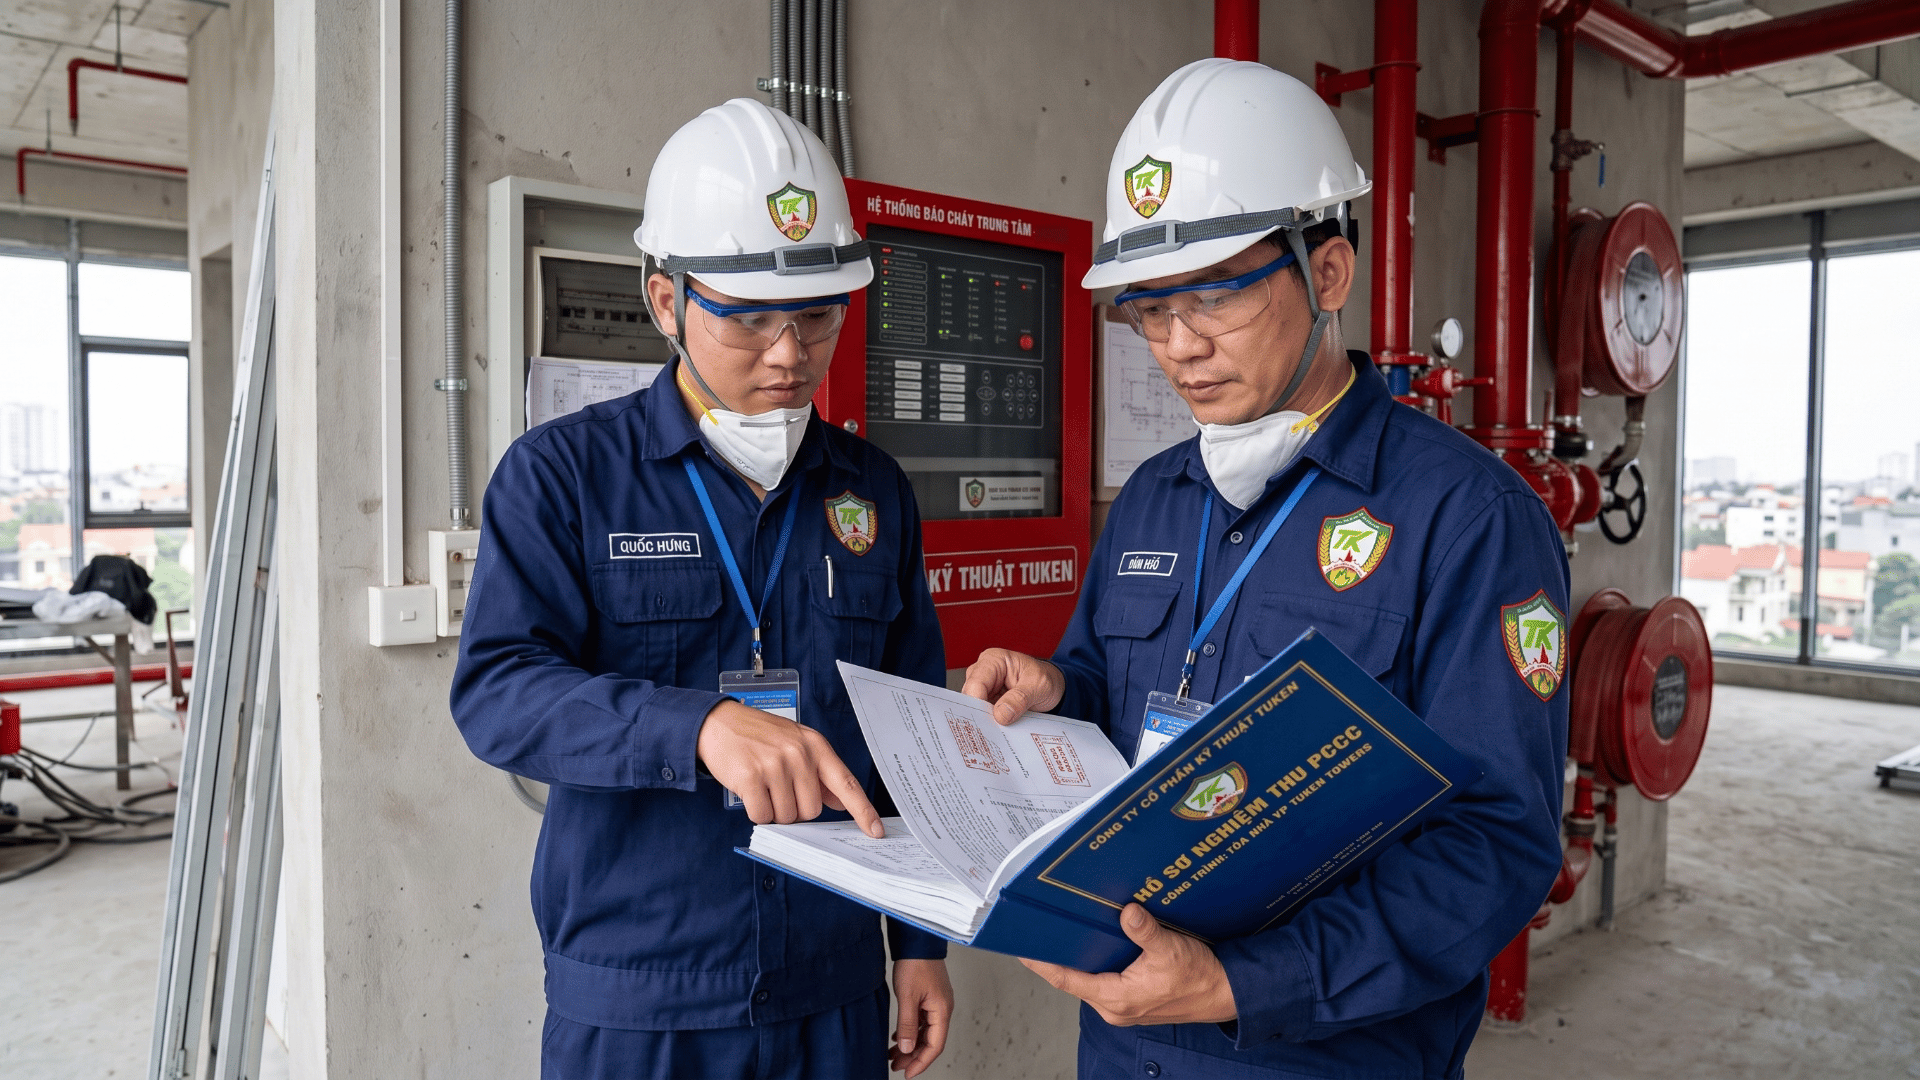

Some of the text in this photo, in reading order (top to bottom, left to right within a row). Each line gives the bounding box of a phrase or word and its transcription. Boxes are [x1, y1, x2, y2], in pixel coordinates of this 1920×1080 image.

[1135, 168, 1161, 190] TK
[778, 196, 805, 215] TK
[867, 195, 882, 215] HỆ
[885, 198, 921, 220] THỐNG
[947, 210, 974, 228] CHÁY
[977, 215, 1009, 234] TRUNG
[1011, 219, 1032, 237] TÂM
[838, 507, 864, 525] TK
[620, 536, 691, 553] QUỐC HƯNG
[1332, 528, 1375, 553] TK
[929, 559, 1073, 593] KỸ THUẬT TUKEN
[1522, 619, 1558, 650] TK
[1089, 822, 1123, 850] CÔNG
[1122, 807, 1139, 822] TY
[1212, 715, 1254, 749] THUẬT
[1255, 681, 1299, 717] TUKEN
[1162, 854, 1193, 880] SƠ
[1191, 797, 1270, 858] NGHIỆM
[1266, 765, 1308, 798] THU
[1306, 725, 1363, 770] PCCC
[1190, 774, 1225, 807] TK
[1161, 881, 1192, 906] CÔNG
[1191, 854, 1229, 881] TRÌNH:
[1249, 817, 1274, 838] NHÀ
[1272, 805, 1288, 819] VP
[1289, 777, 1327, 806] TUKEN
[1325, 742, 1373, 779] TOWERS
